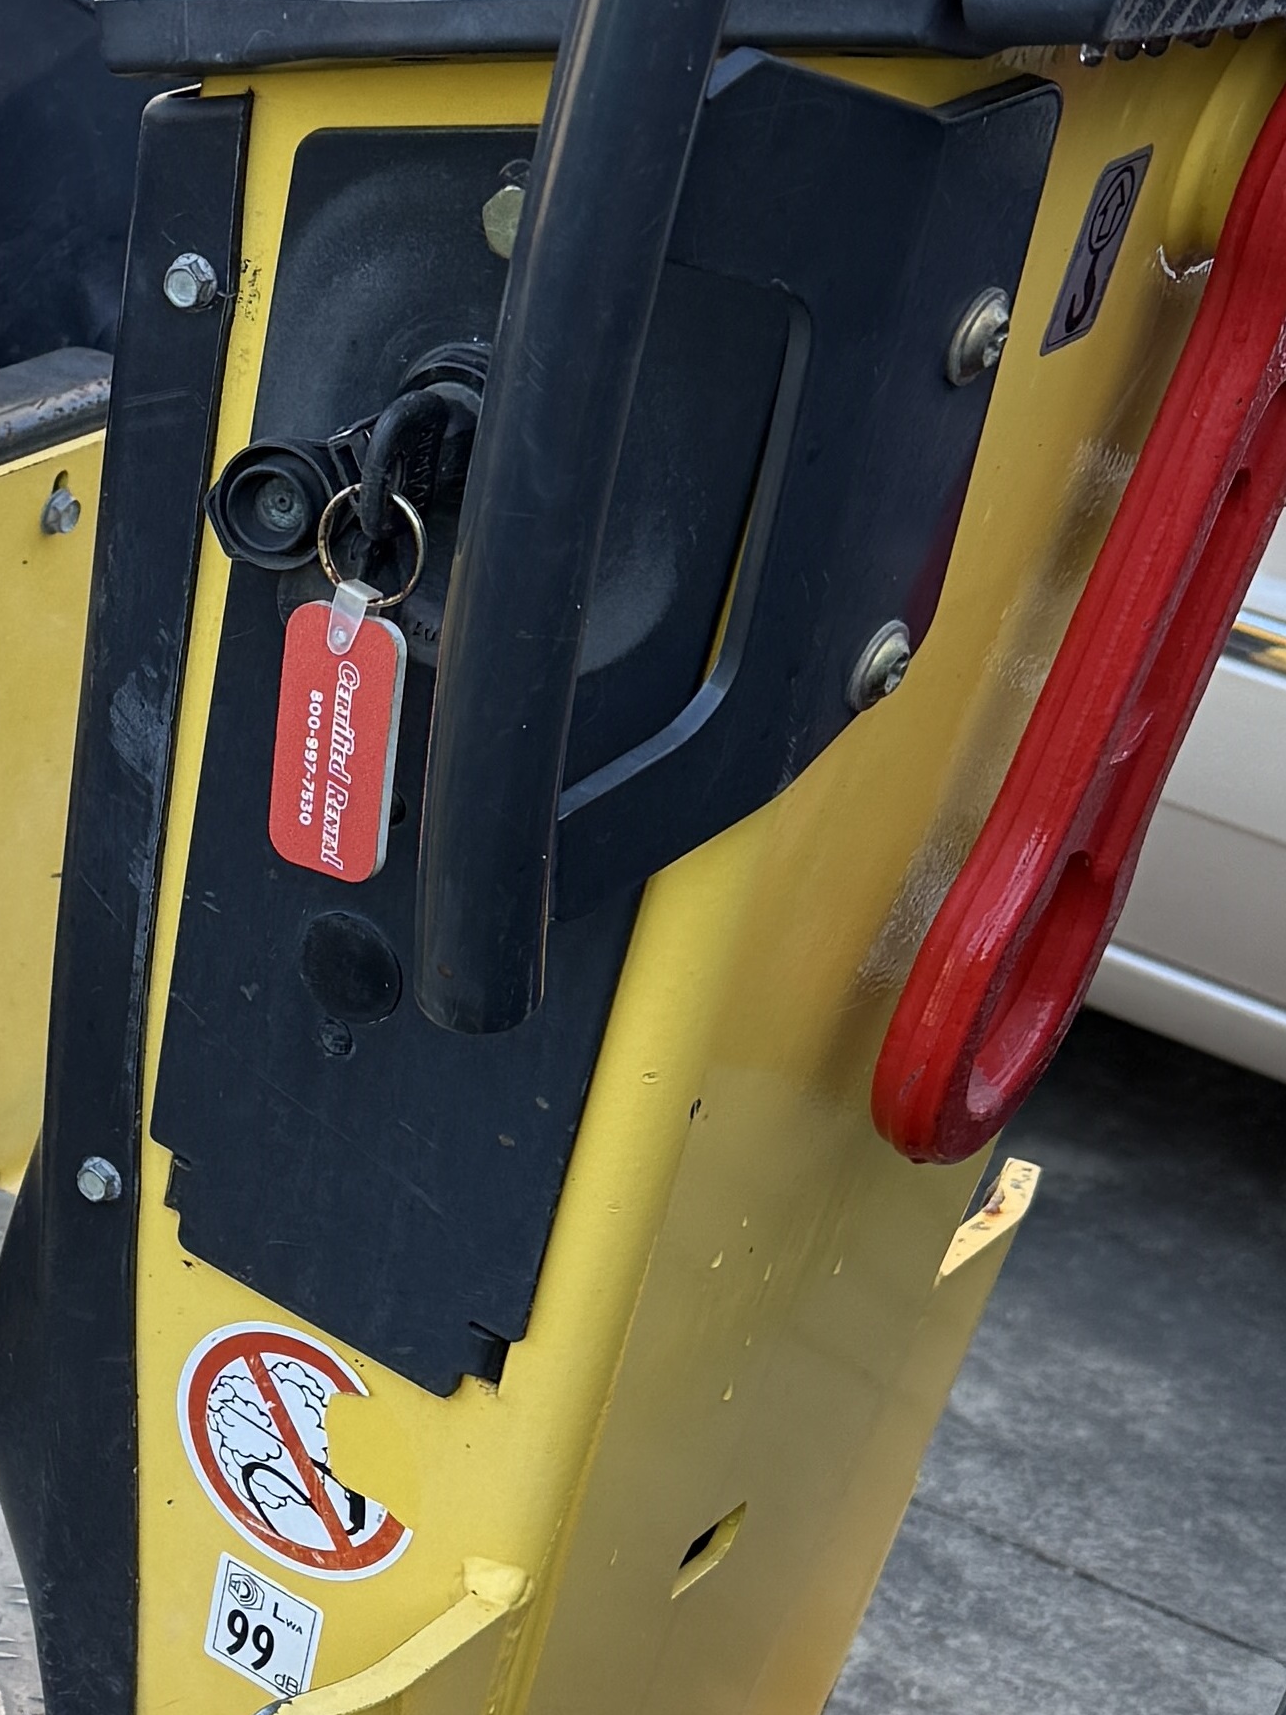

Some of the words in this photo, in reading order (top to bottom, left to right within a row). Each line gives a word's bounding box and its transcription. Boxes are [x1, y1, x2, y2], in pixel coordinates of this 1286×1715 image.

[299, 689, 324, 826] 800-997-7530
[226, 1608, 275, 1671] 99
[274, 1673, 299, 1695] dB
